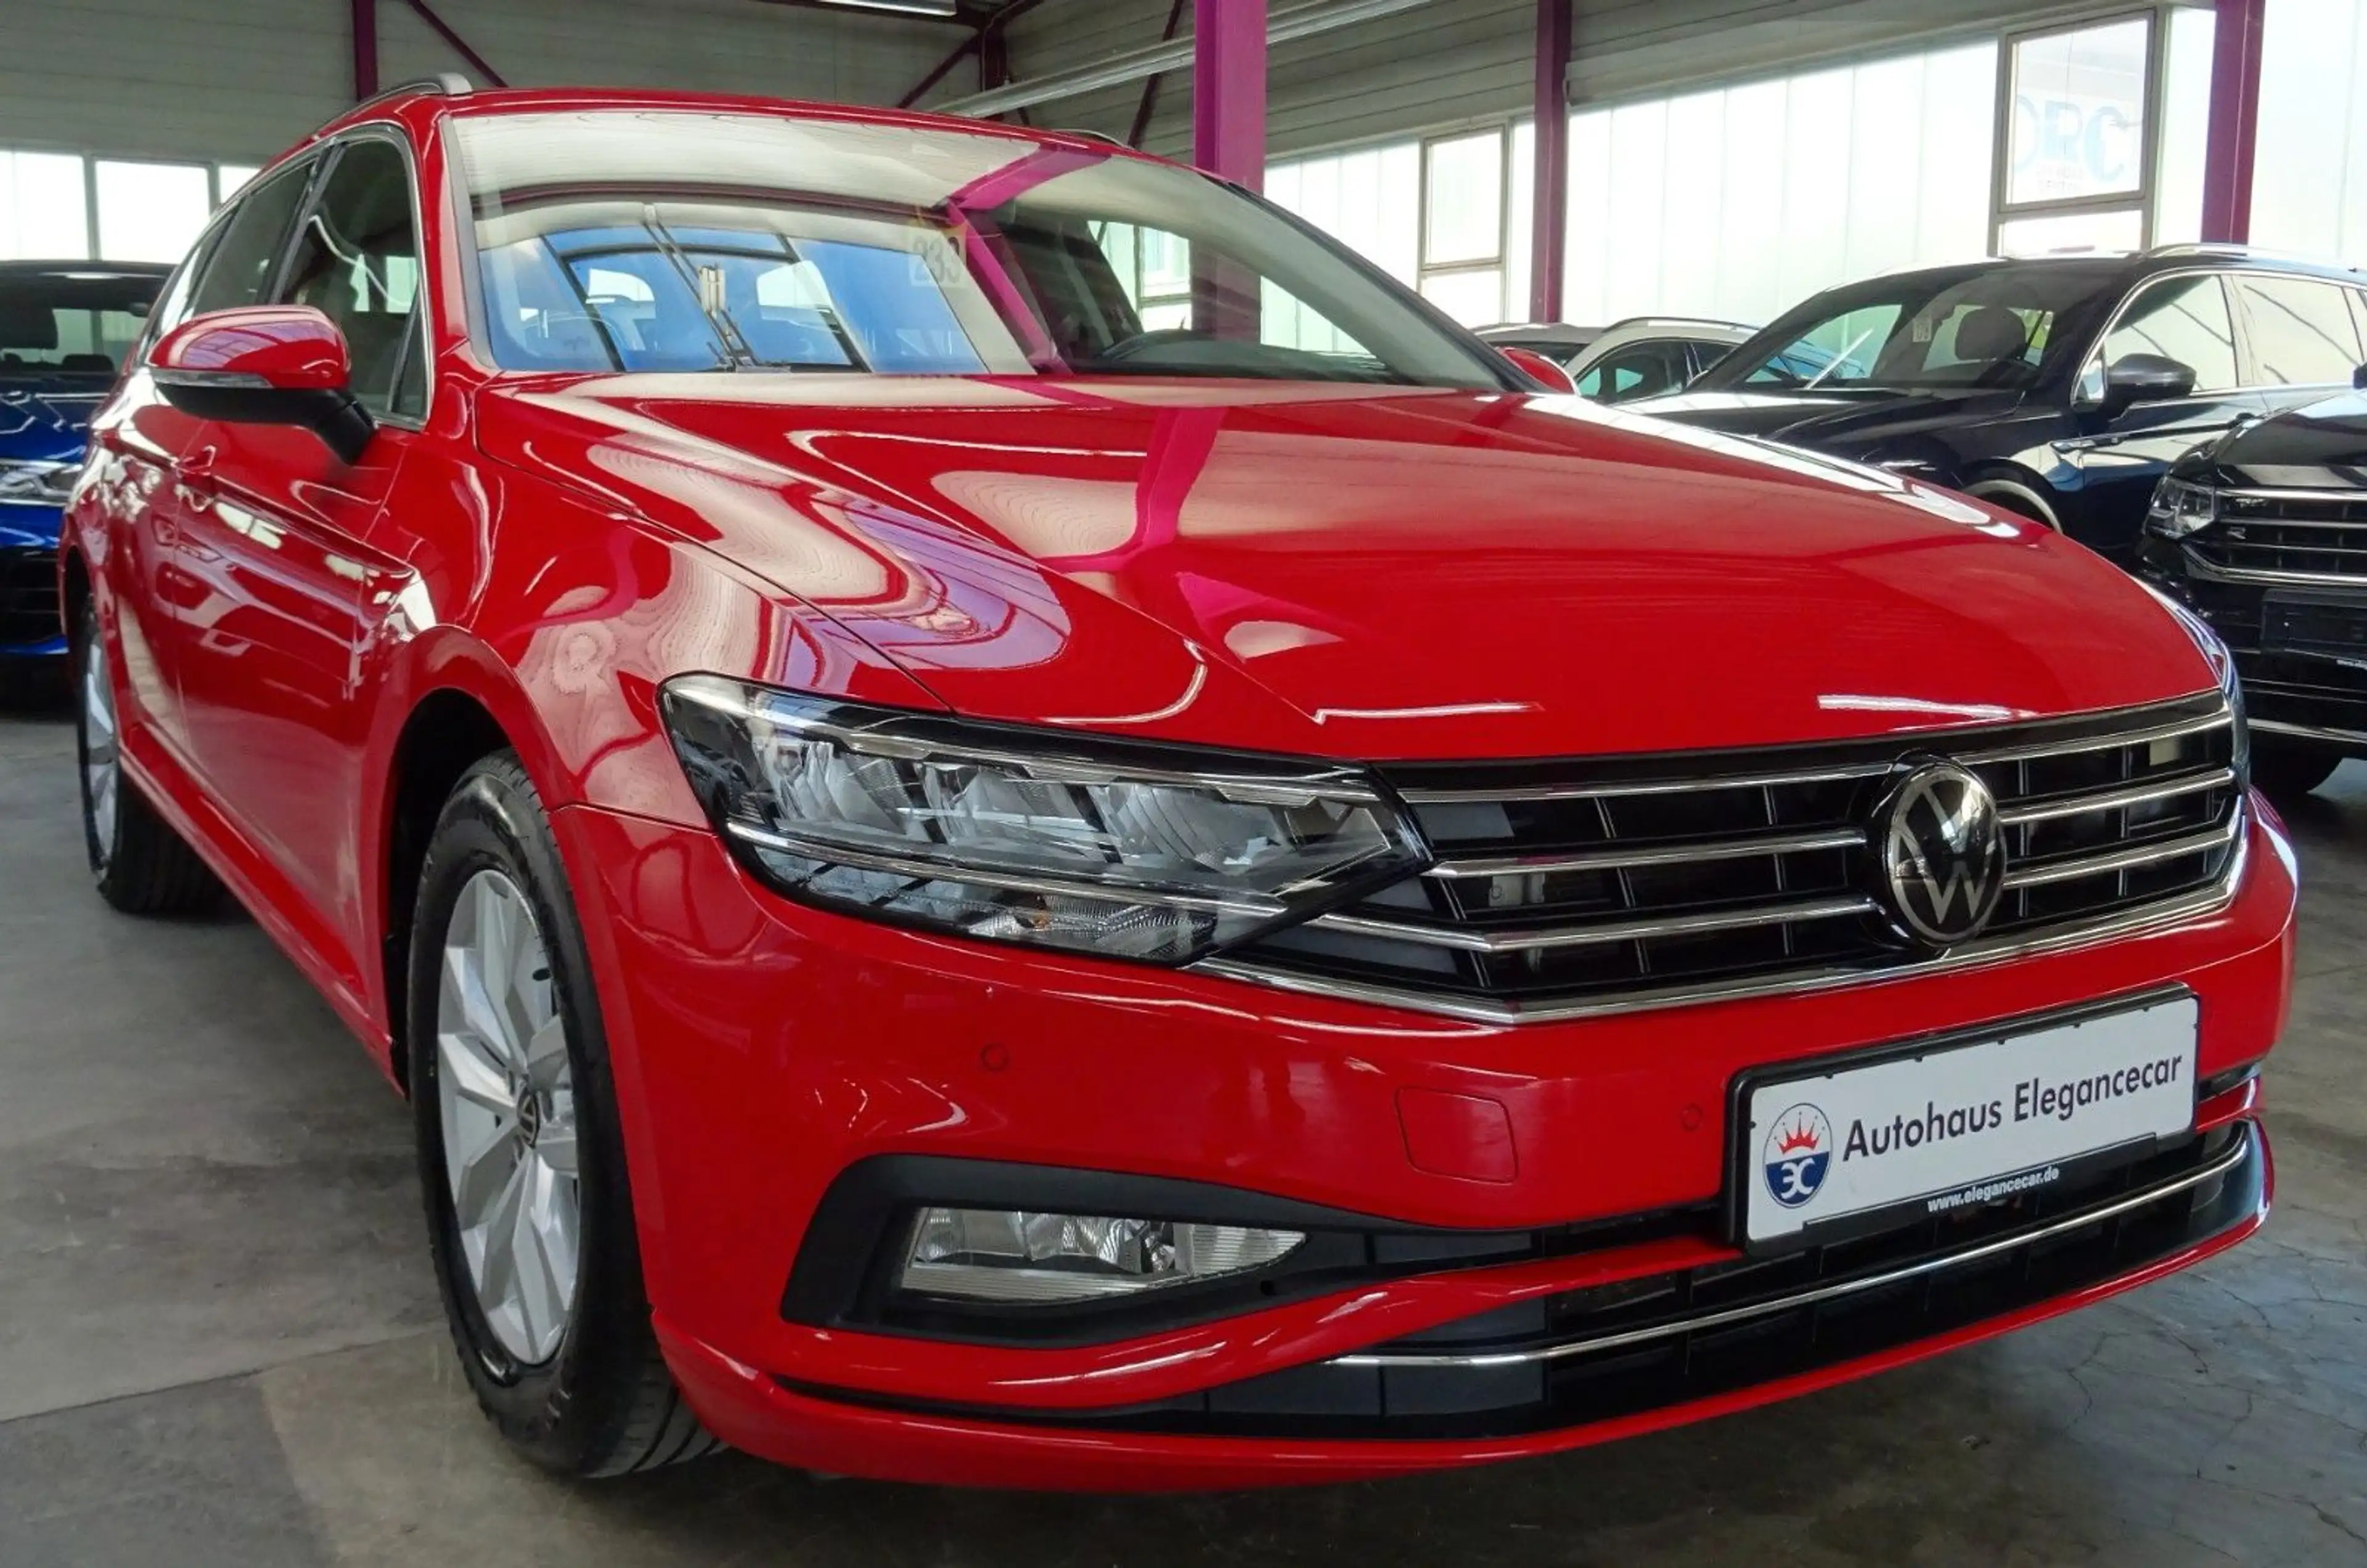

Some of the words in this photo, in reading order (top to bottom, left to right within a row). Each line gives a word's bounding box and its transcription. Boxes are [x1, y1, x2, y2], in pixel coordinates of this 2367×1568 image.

[1842, 1100, 2002, 1162] Autohaus
[2014, 1053, 2183, 1122] Elegancecar
[1927, 1165, 2060, 1213] www.elegancecar.de
